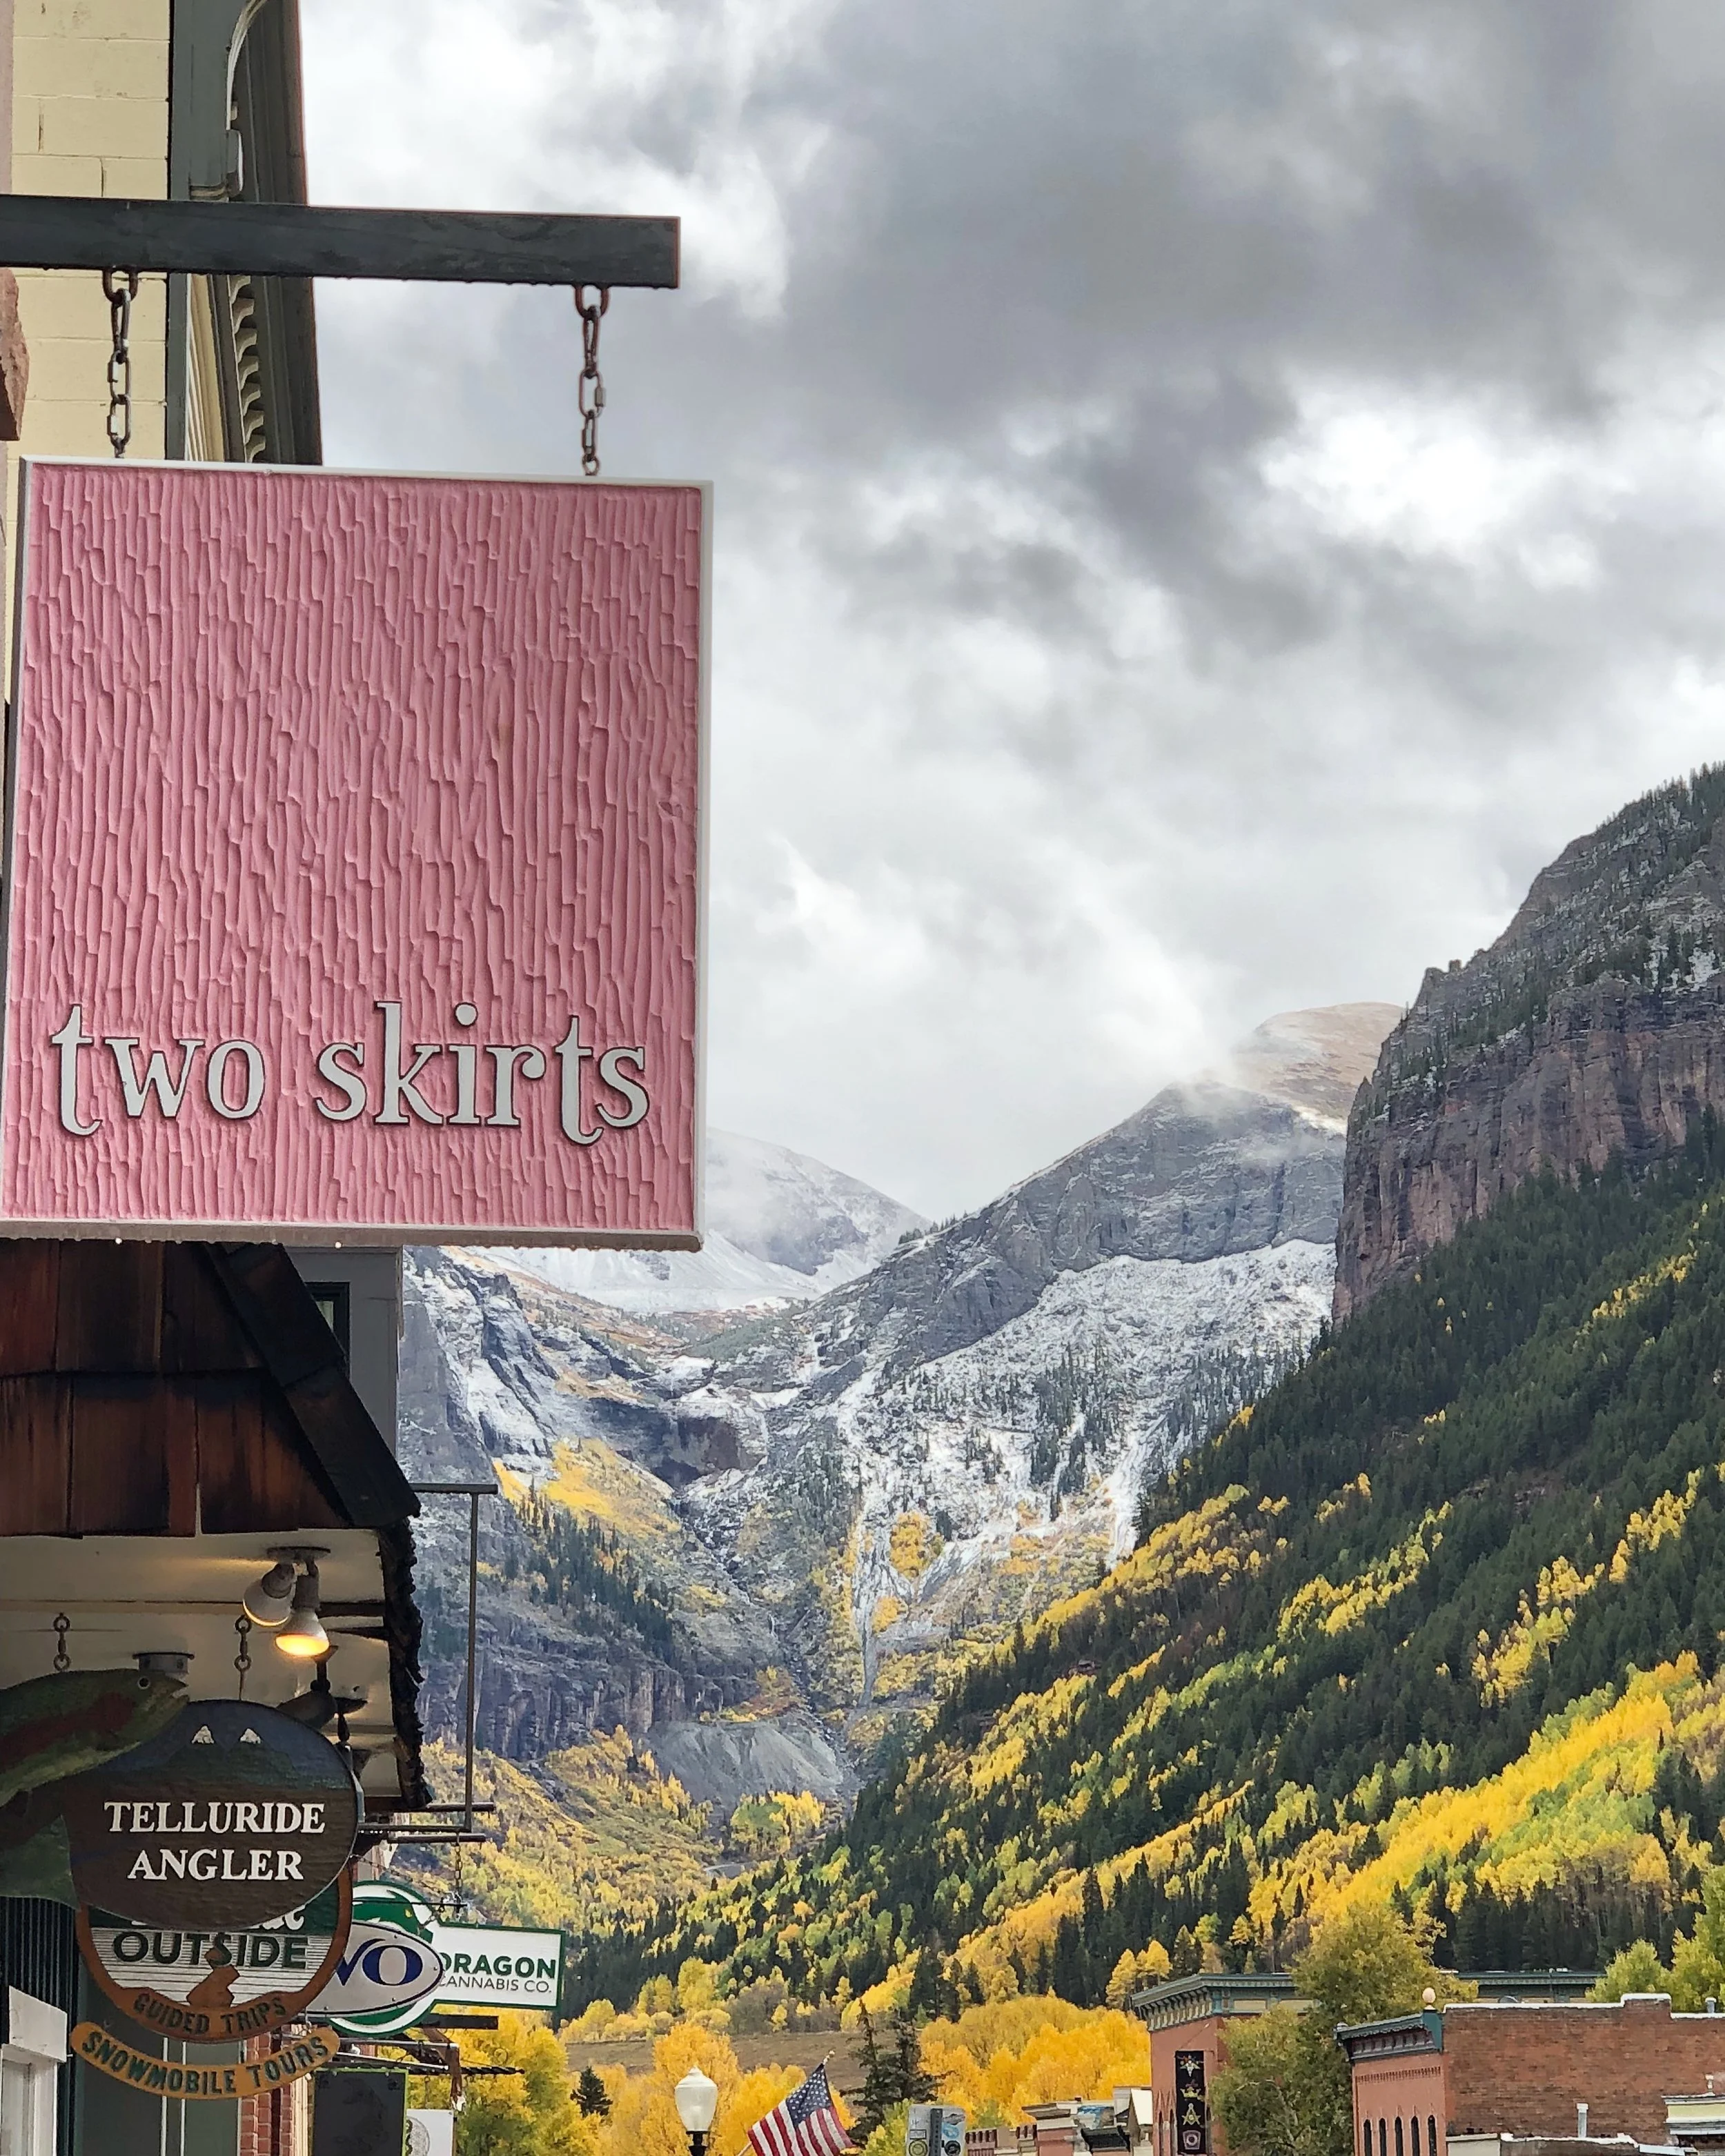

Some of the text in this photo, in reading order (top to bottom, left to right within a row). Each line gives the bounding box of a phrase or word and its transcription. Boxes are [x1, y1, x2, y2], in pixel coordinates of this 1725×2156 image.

[50, 1000, 651, 1147] two skirts
[104, 1801, 326, 1834] TELLURIDE
[127, 1848, 304, 1881] ANGLER
[112, 1931, 309, 1968] OUTSIDE
[524, 1979, 553, 1994] CO.
[132, 1992, 287, 2035] GUIDED TRIPS
[81, 2030, 329, 2095] SNOWMOBILE TOURS
